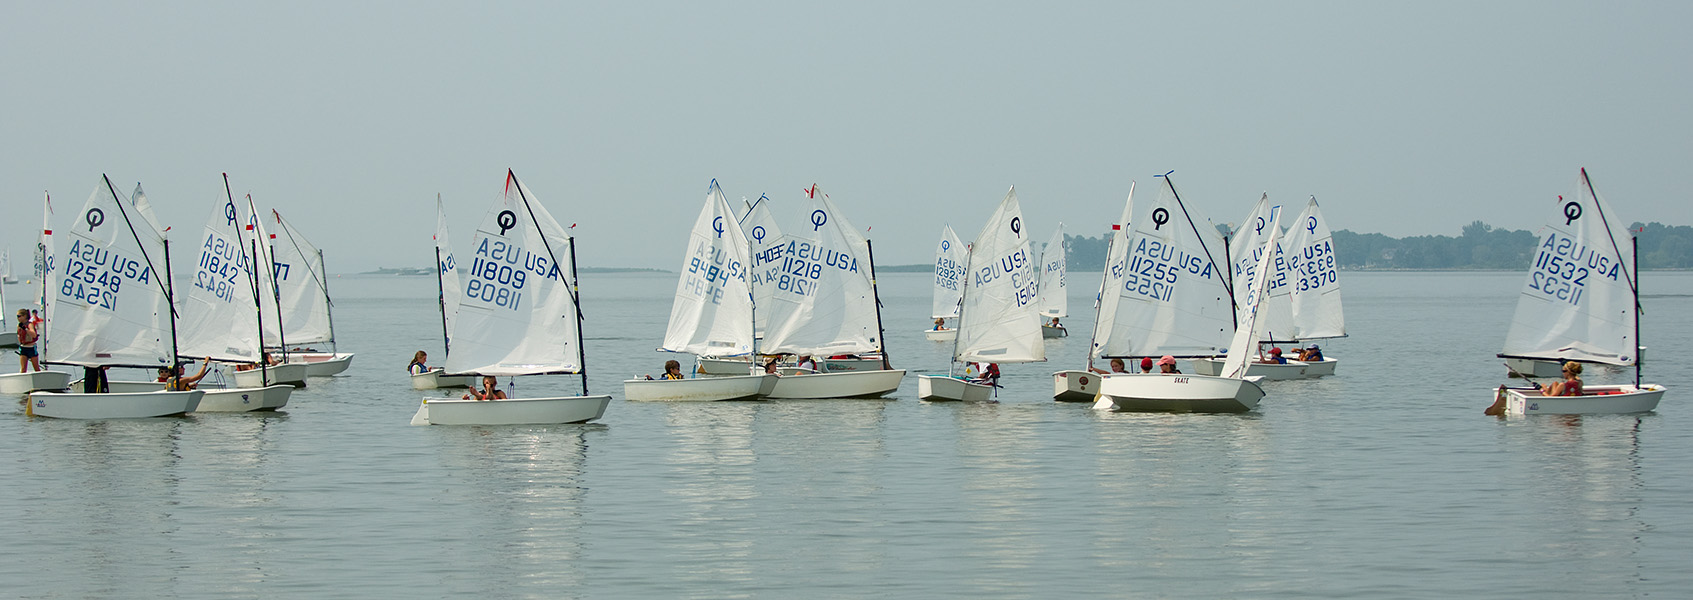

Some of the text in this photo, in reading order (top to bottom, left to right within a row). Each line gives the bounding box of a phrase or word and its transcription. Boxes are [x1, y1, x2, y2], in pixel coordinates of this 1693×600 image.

[825, 249, 858, 274] USA
[1001, 248, 1028, 273] USA
[1179, 251, 1212, 279] USA
[1304, 240, 1332, 260] USA
[65, 258, 121, 294] 12548
[112, 254, 151, 285] USA
[200, 251, 239, 285] 11842
[470, 257, 526, 289] 11809
[524, 251, 559, 281] USA
[689, 257, 730, 287] 9484
[782, 257, 822, 280] 11218
[1130, 255, 1179, 283] 11255
[1536, 251, 1590, 287] 11532
[1588, 250, 1620, 281] USA
